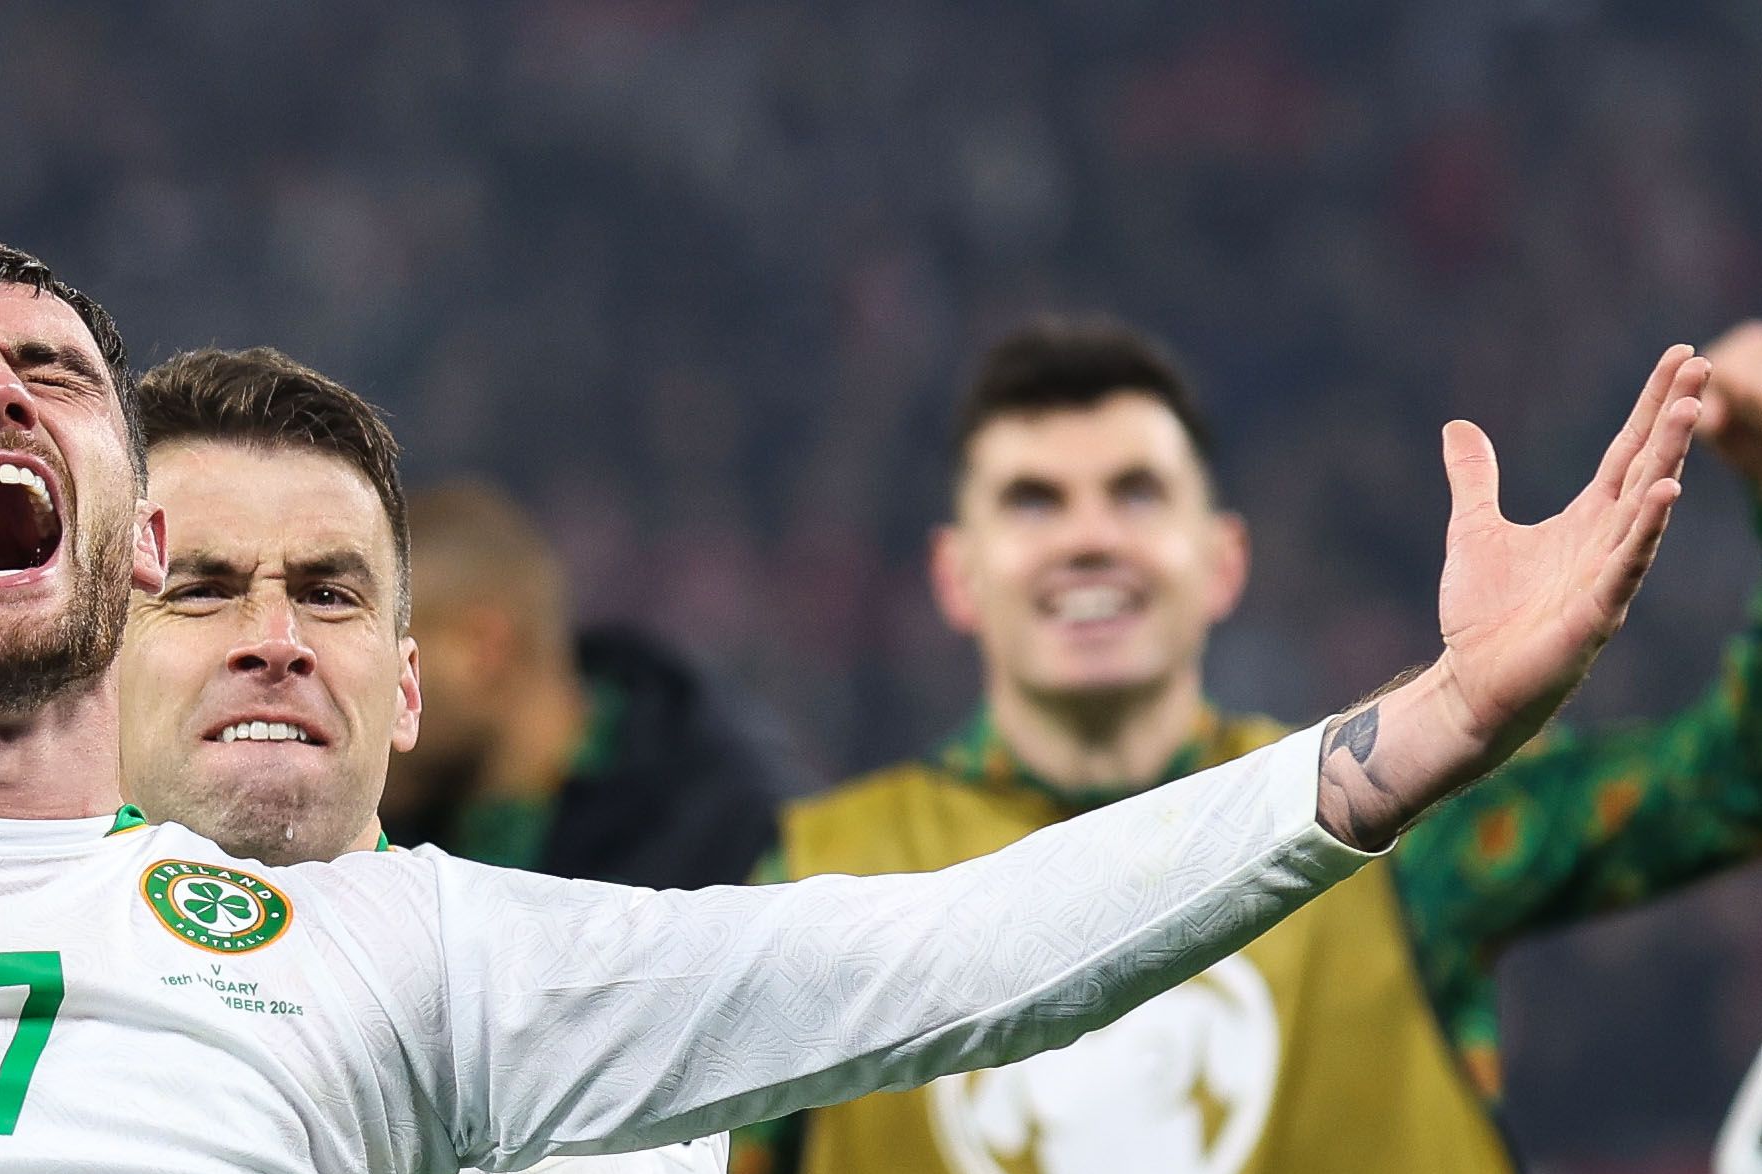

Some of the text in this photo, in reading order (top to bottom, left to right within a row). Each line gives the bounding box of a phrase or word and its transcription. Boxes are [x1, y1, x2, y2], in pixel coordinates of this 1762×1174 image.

[153, 864, 273, 899] IRELAND
[176, 922, 265, 948] FOOTBALL
[210, 963, 222, 975] V
[160, 973, 304, 1016] 16th MBER 2025
[203, 977, 259, 997] NGARY
